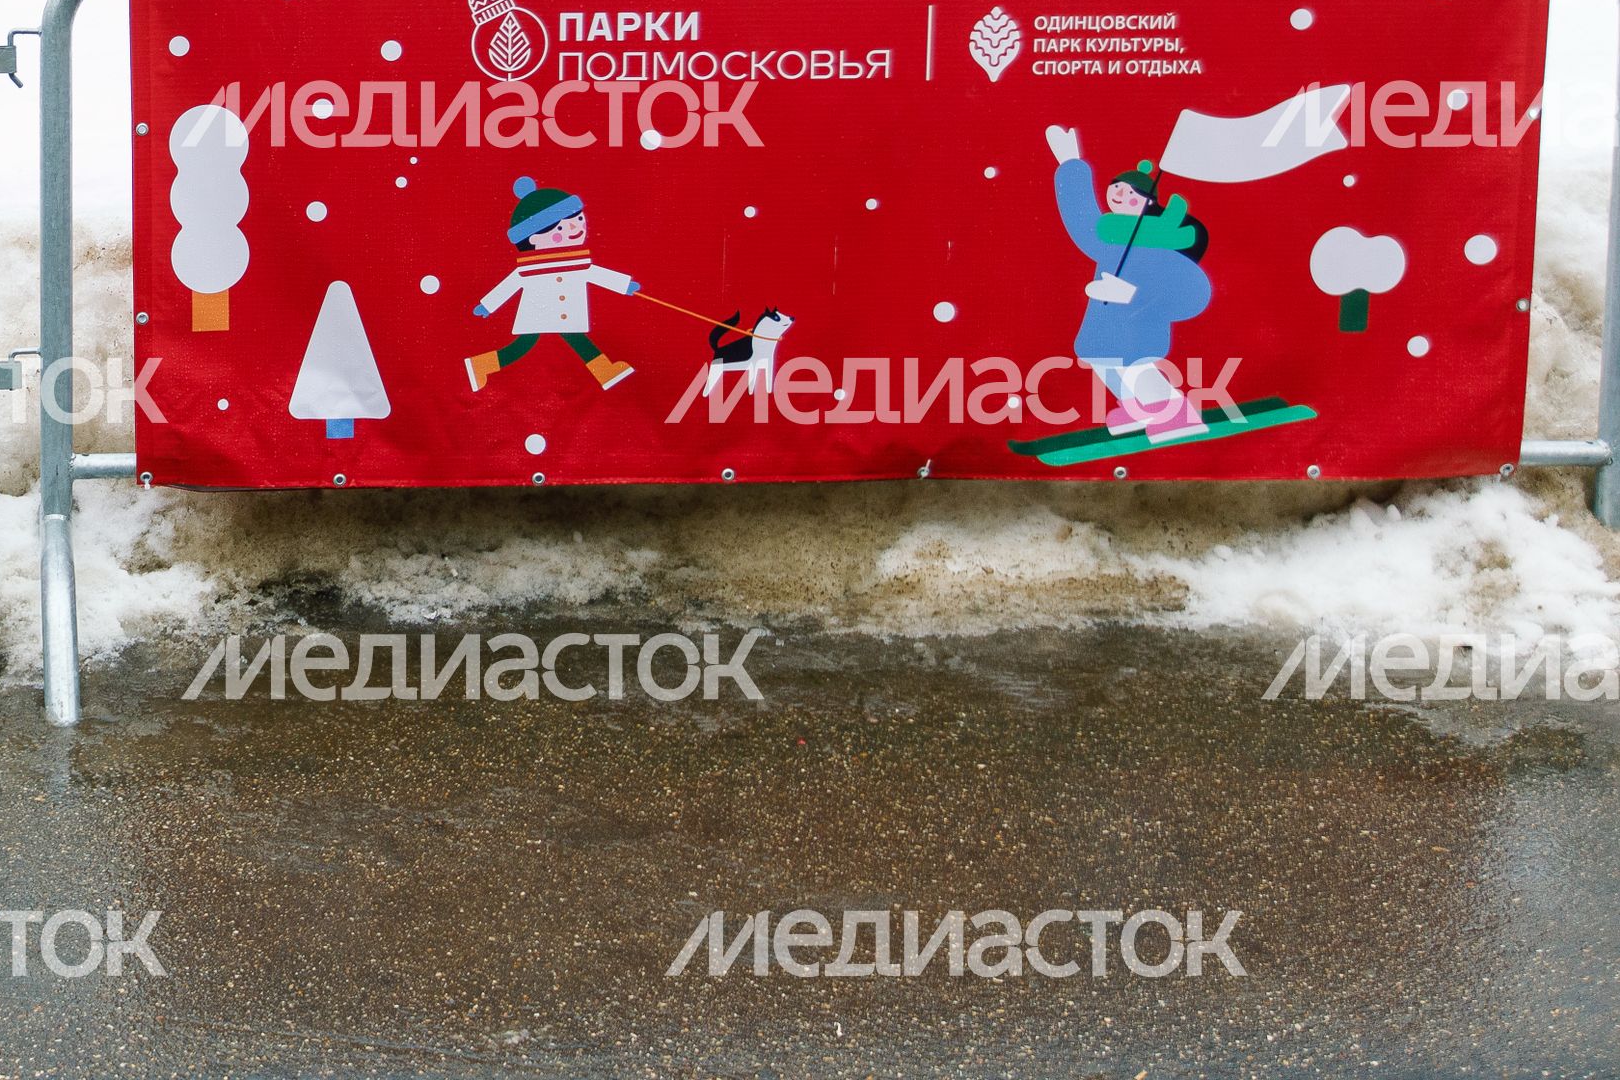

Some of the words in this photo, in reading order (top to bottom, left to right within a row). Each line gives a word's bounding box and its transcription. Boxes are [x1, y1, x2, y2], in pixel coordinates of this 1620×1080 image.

[559, 12, 699, 42] ПАРКИ
[1034, 12, 1176, 34] ОДИНЦОВСКИЙ
[1033, 38, 1082, 54] ПАРК
[1085, 36, 1184, 56] КУЛЬТУРЫ,
[558, 49, 891, 82] ПОДМОСКОВЬЯ
[1032, 59, 1102, 76] СПОРТА
[1108, 59, 1120, 75] И
[1125, 59, 1202, 78] ОТДЫХА
